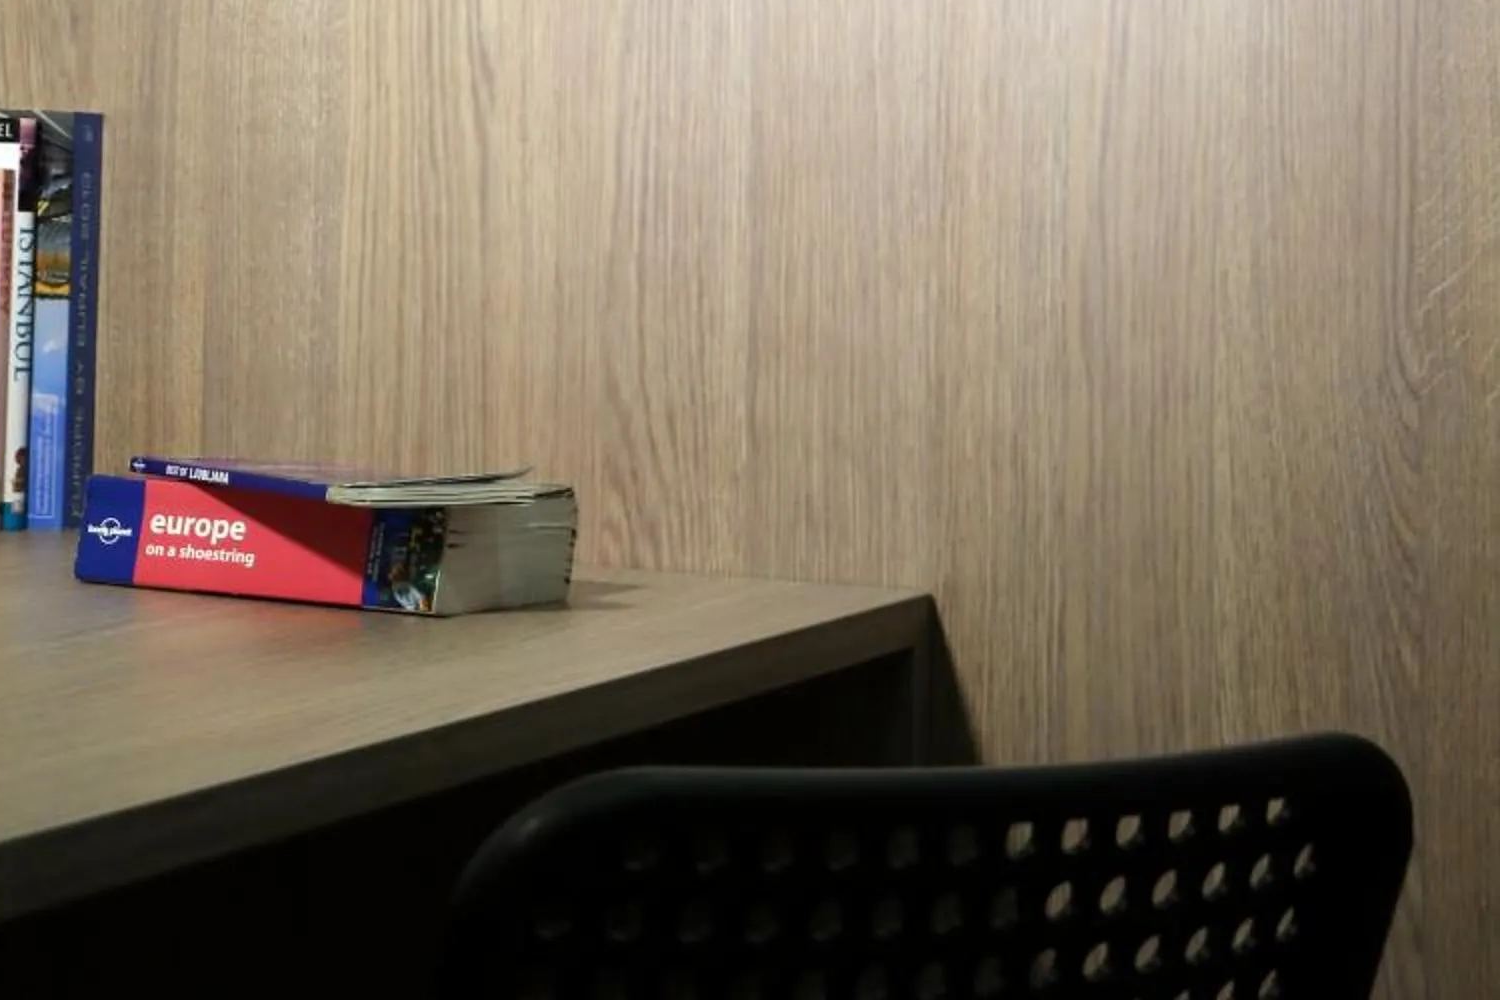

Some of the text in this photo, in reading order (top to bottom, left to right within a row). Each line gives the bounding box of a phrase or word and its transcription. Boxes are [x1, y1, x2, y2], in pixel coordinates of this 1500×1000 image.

[13, 228, 35, 382] ISTANBUL
[150, 513, 246, 545] europe
[145, 543, 256, 567] on a shoestring
